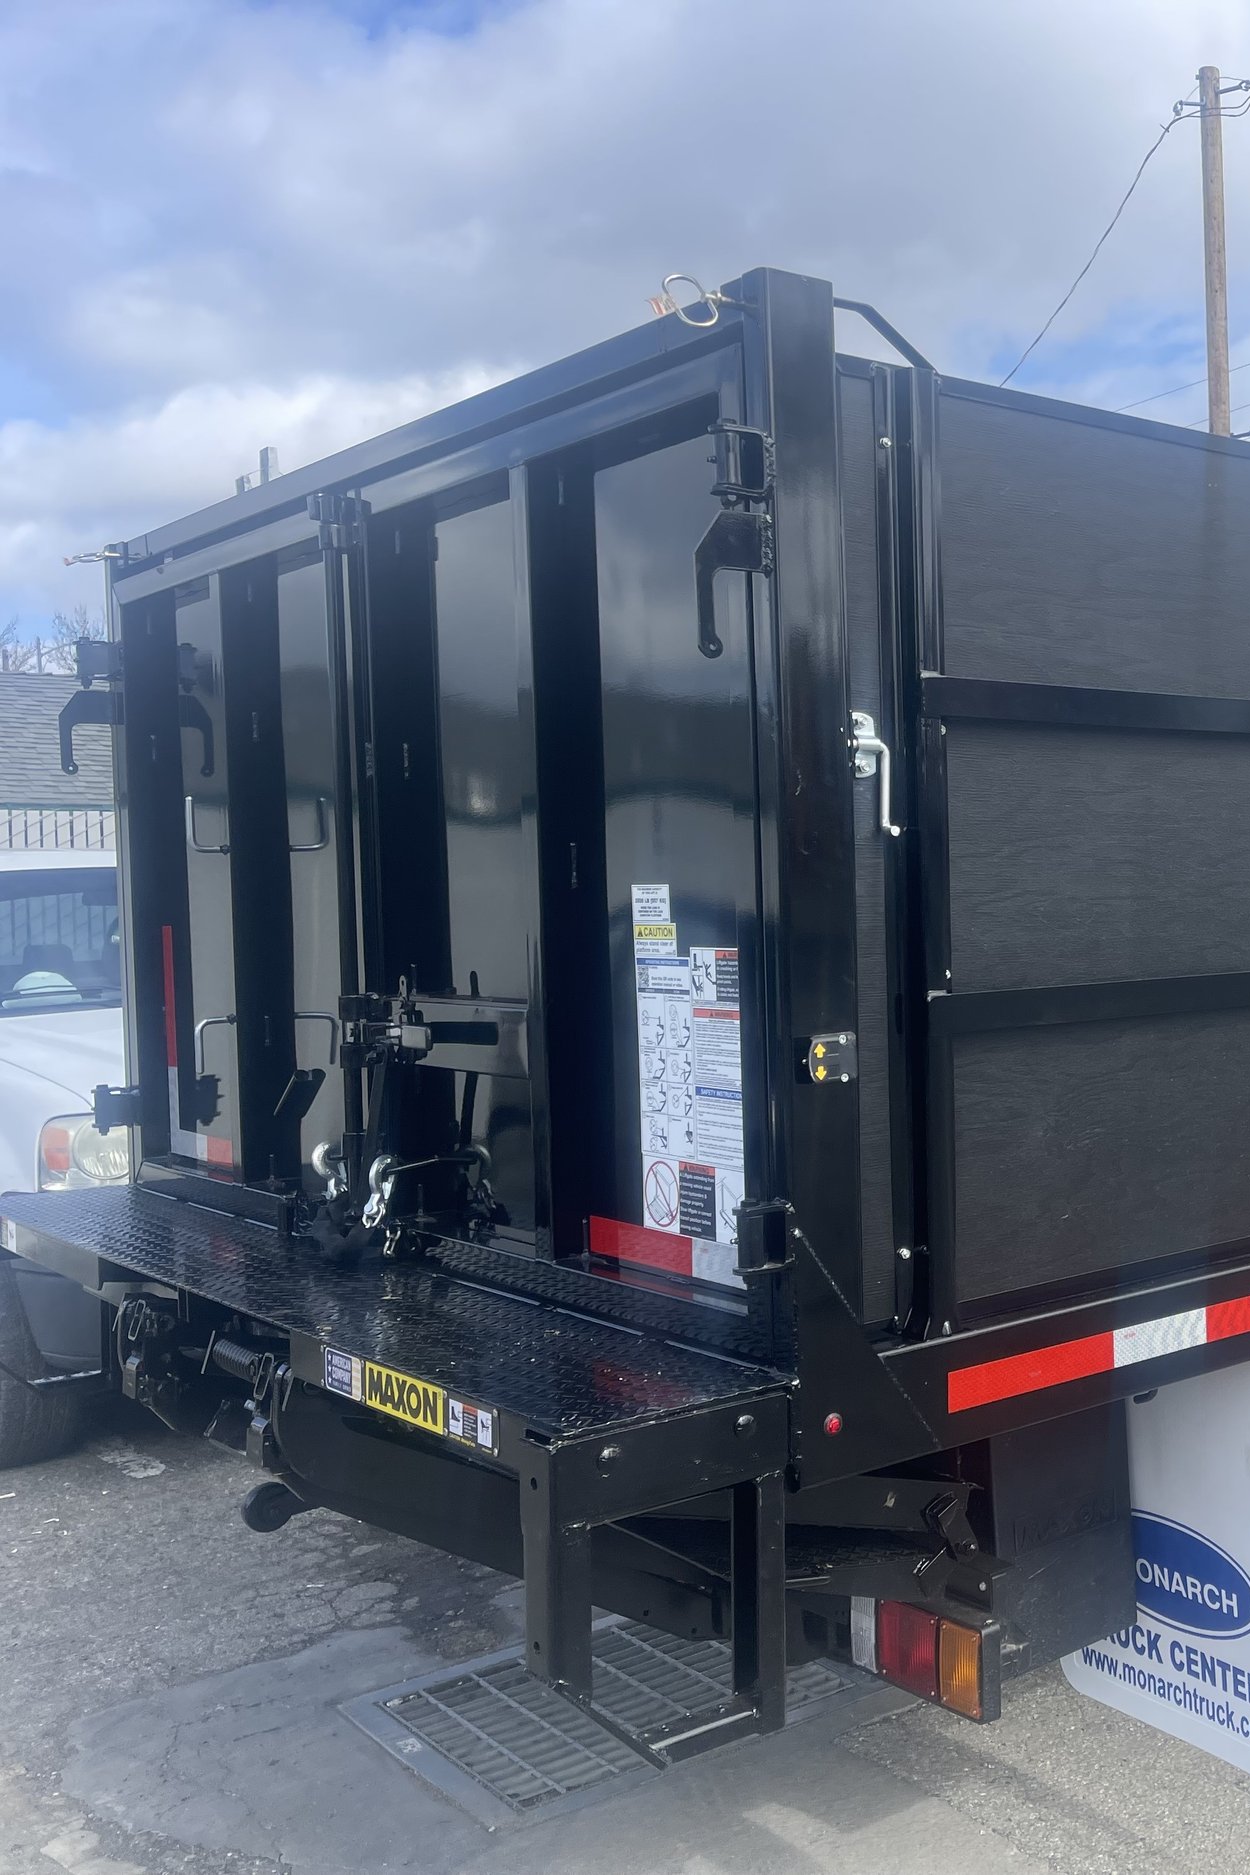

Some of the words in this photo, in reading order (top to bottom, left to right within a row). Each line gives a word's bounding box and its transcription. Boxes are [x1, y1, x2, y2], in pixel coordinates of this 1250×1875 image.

[643, 926, 673, 938] CAUTION
[331, 1354, 351, 1372] AMERICAN
[331, 1365, 352, 1385] COMPANY
[368, 1368, 438, 1427] MAXON
[1135, 1558, 1239, 1618] ONARCH
[1104, 1624, 1164, 1665] UCK
